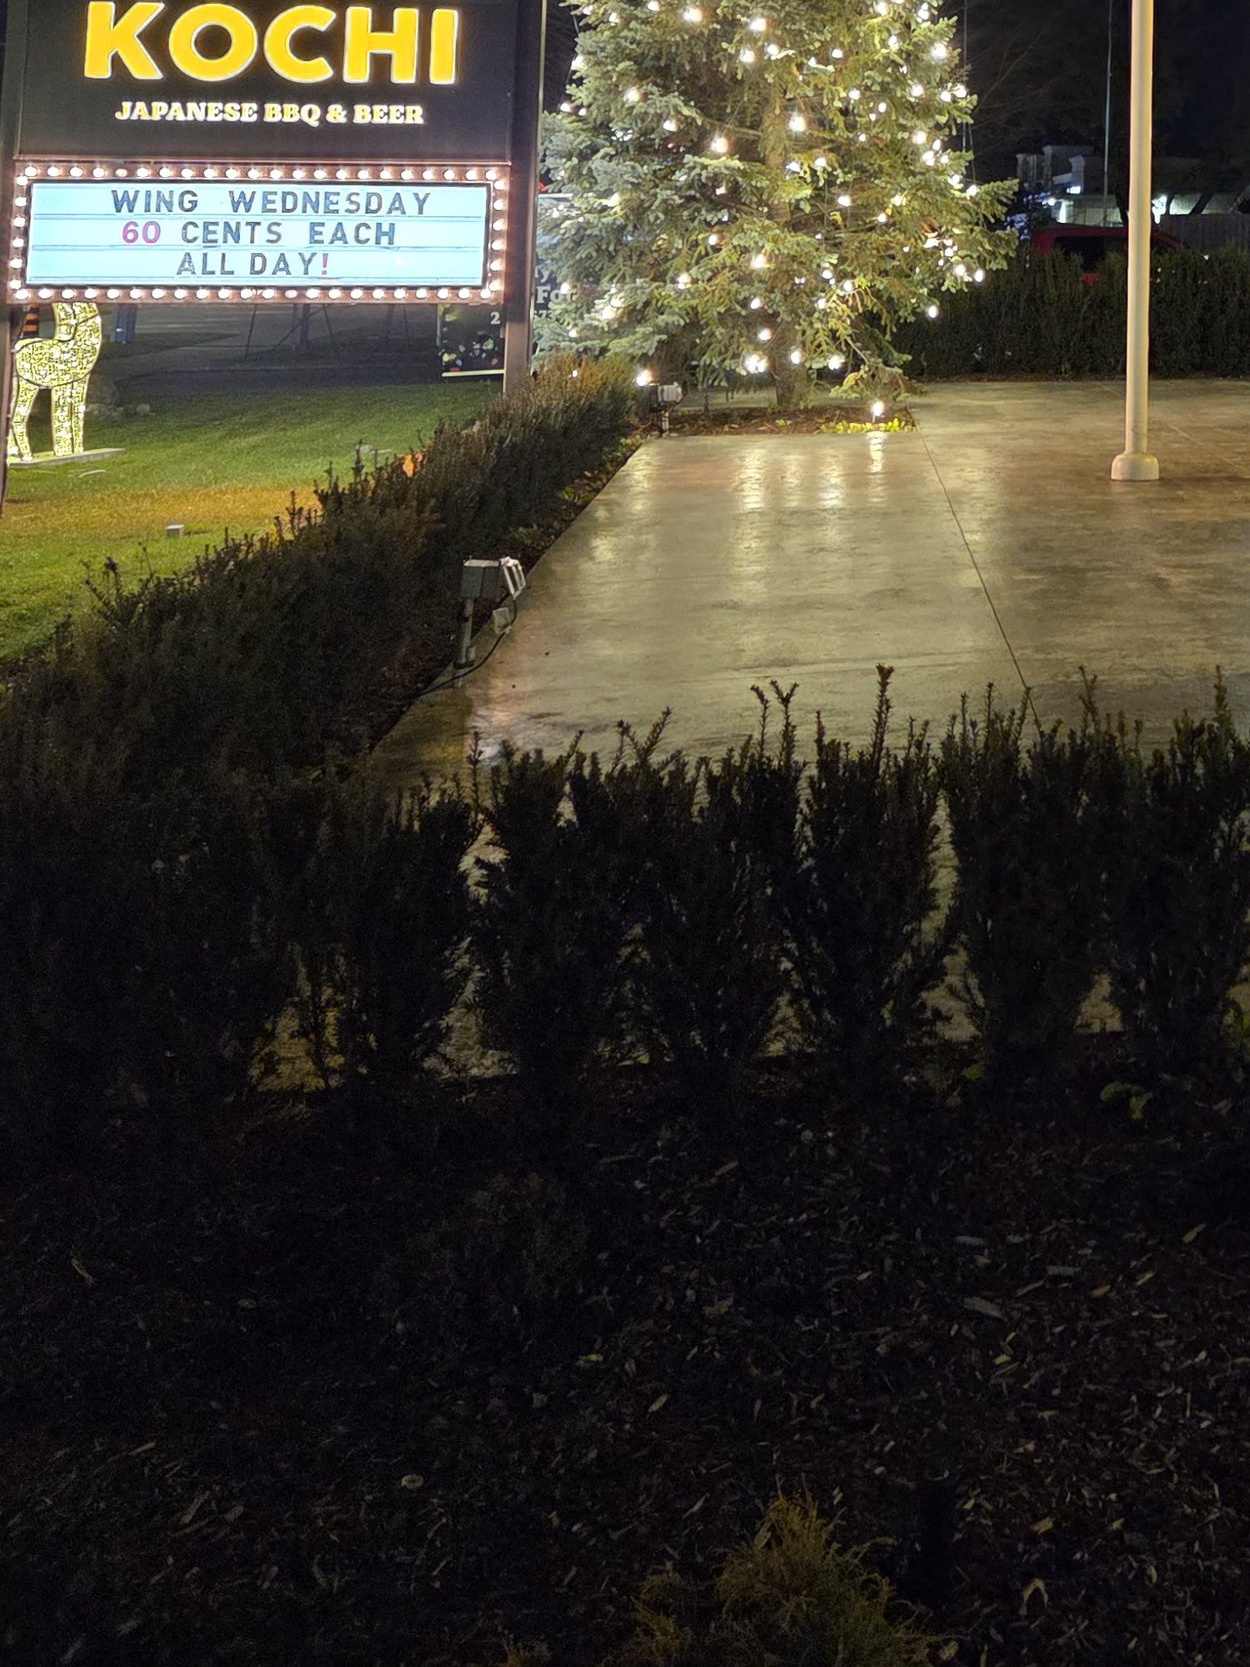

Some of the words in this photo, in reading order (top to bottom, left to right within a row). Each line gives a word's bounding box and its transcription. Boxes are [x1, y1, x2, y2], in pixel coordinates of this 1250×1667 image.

[84, 1, 458, 84] KOCHI
[115, 102, 257, 122] JAPANESE
[263, 103, 321, 126] BBQ
[326, 105, 347, 122] &
[353, 105, 424, 124] BEER
[111, 190, 198, 213] WING
[228, 190, 431, 214] WEDNESDAY
[121, 221, 161, 244] 60
[181, 221, 282, 244] CENTS
[309, 222, 396, 245] EACH
[176, 252, 235, 275] ALL
[250, 252, 328, 276] DAY!
